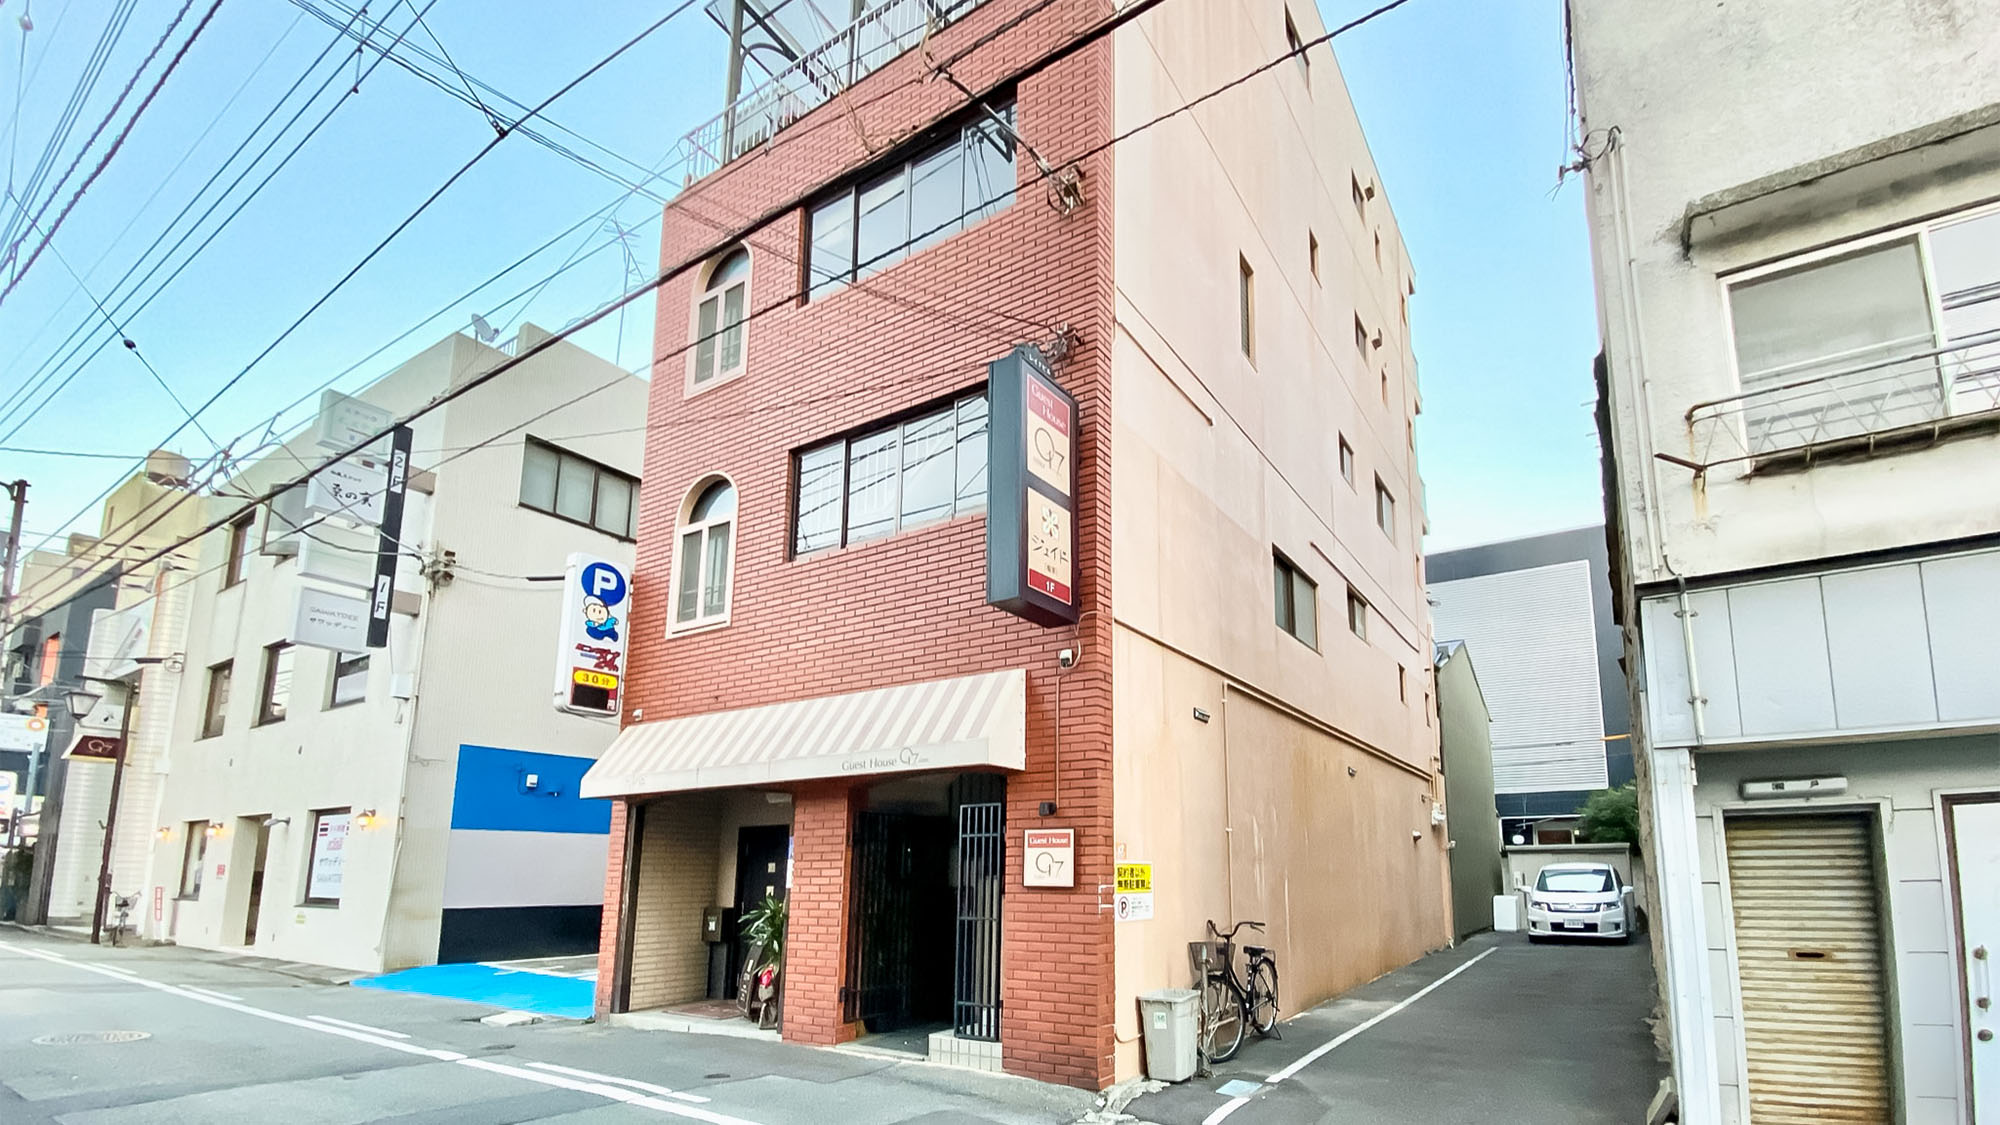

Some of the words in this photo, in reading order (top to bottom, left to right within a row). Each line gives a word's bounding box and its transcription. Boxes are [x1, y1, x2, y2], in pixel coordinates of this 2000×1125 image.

[1032, 384, 1053, 409] Guest
[1042, 404, 1067, 431] House
[1032, 535, 1069, 565] ジェイド
[593, 568, 617, 596] P
[1046, 581, 1055, 593] 1F
[841, 759, 866, 771] Guest
[869, 756, 897, 769] House
